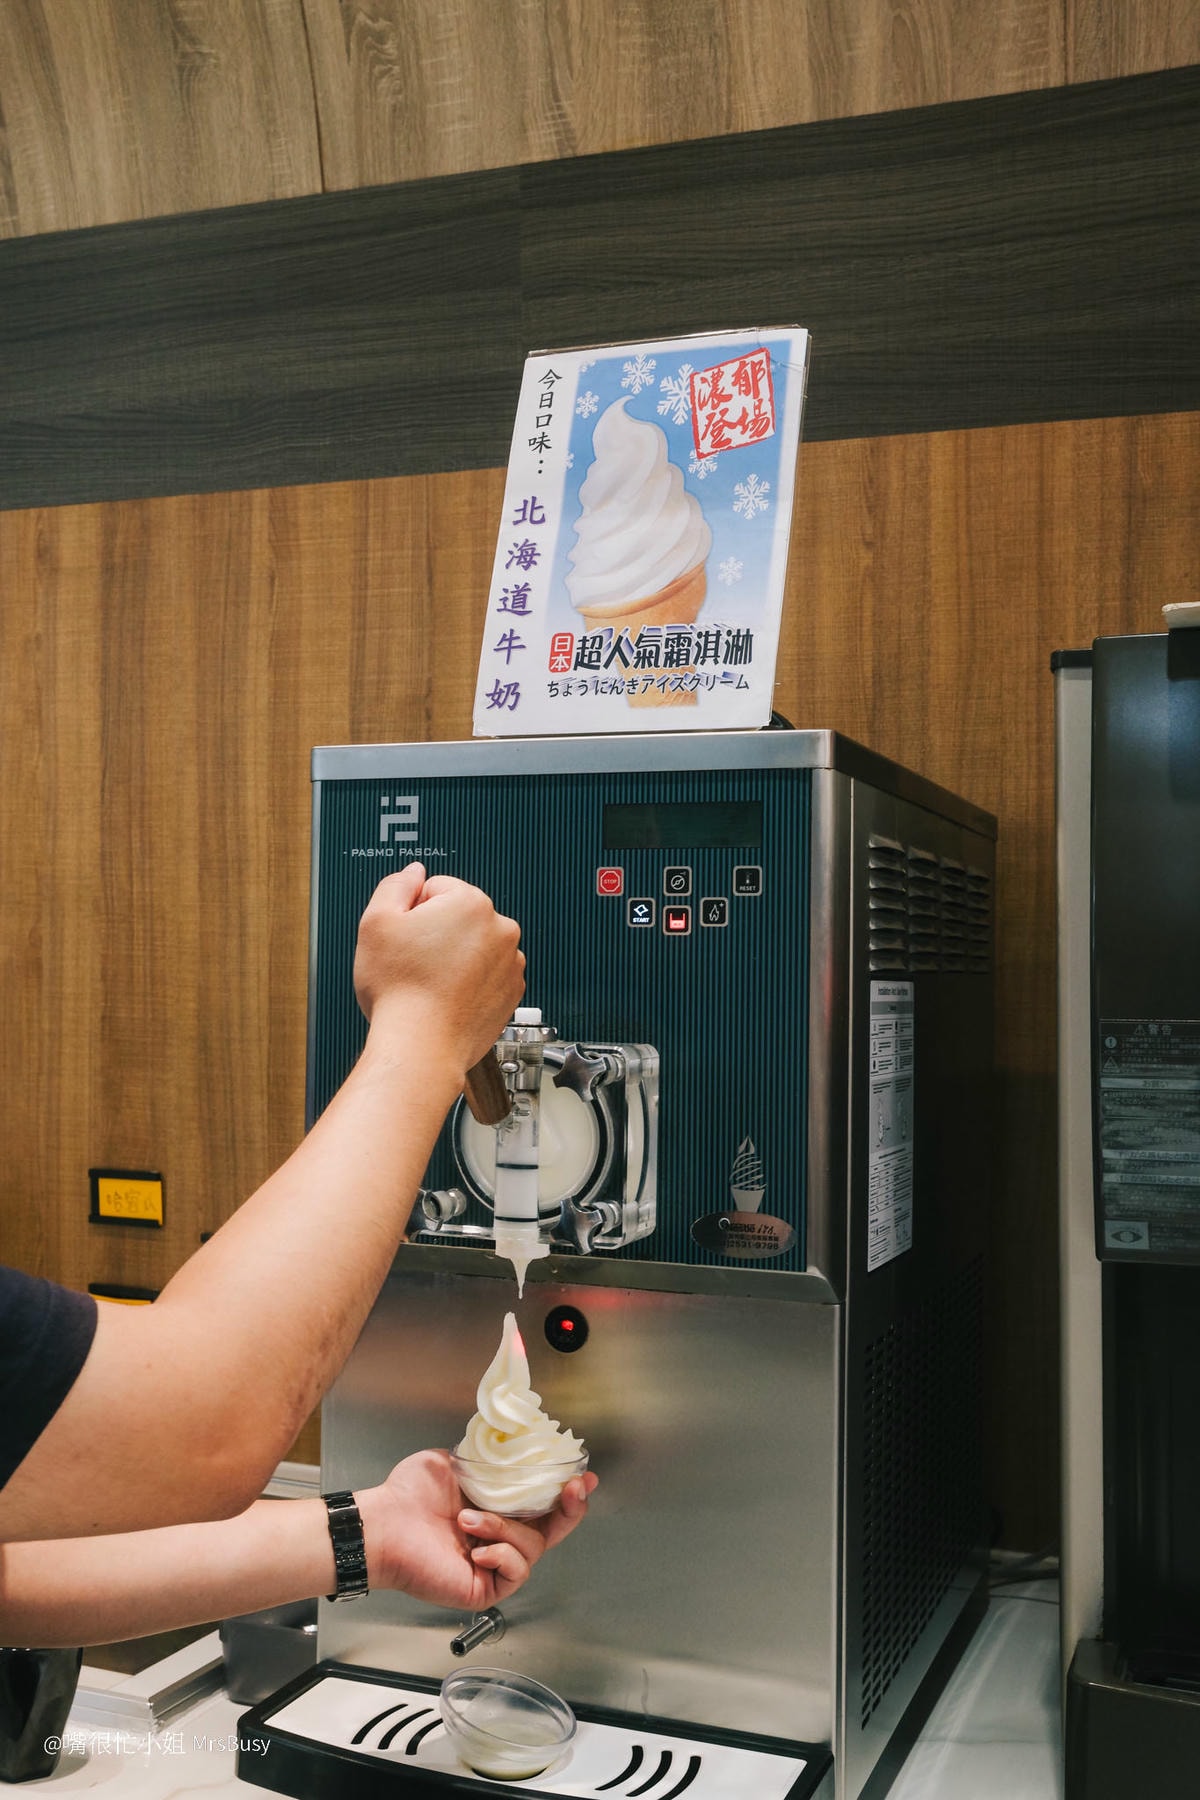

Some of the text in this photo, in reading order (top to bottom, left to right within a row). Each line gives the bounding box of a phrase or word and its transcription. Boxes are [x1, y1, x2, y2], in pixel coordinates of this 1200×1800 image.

[485, 495, 547, 712] 北海道牛奶
[573, 628, 753, 671] 超人氣霜淇淋
[351, 847, 447, 858] PASMO PASCAL
